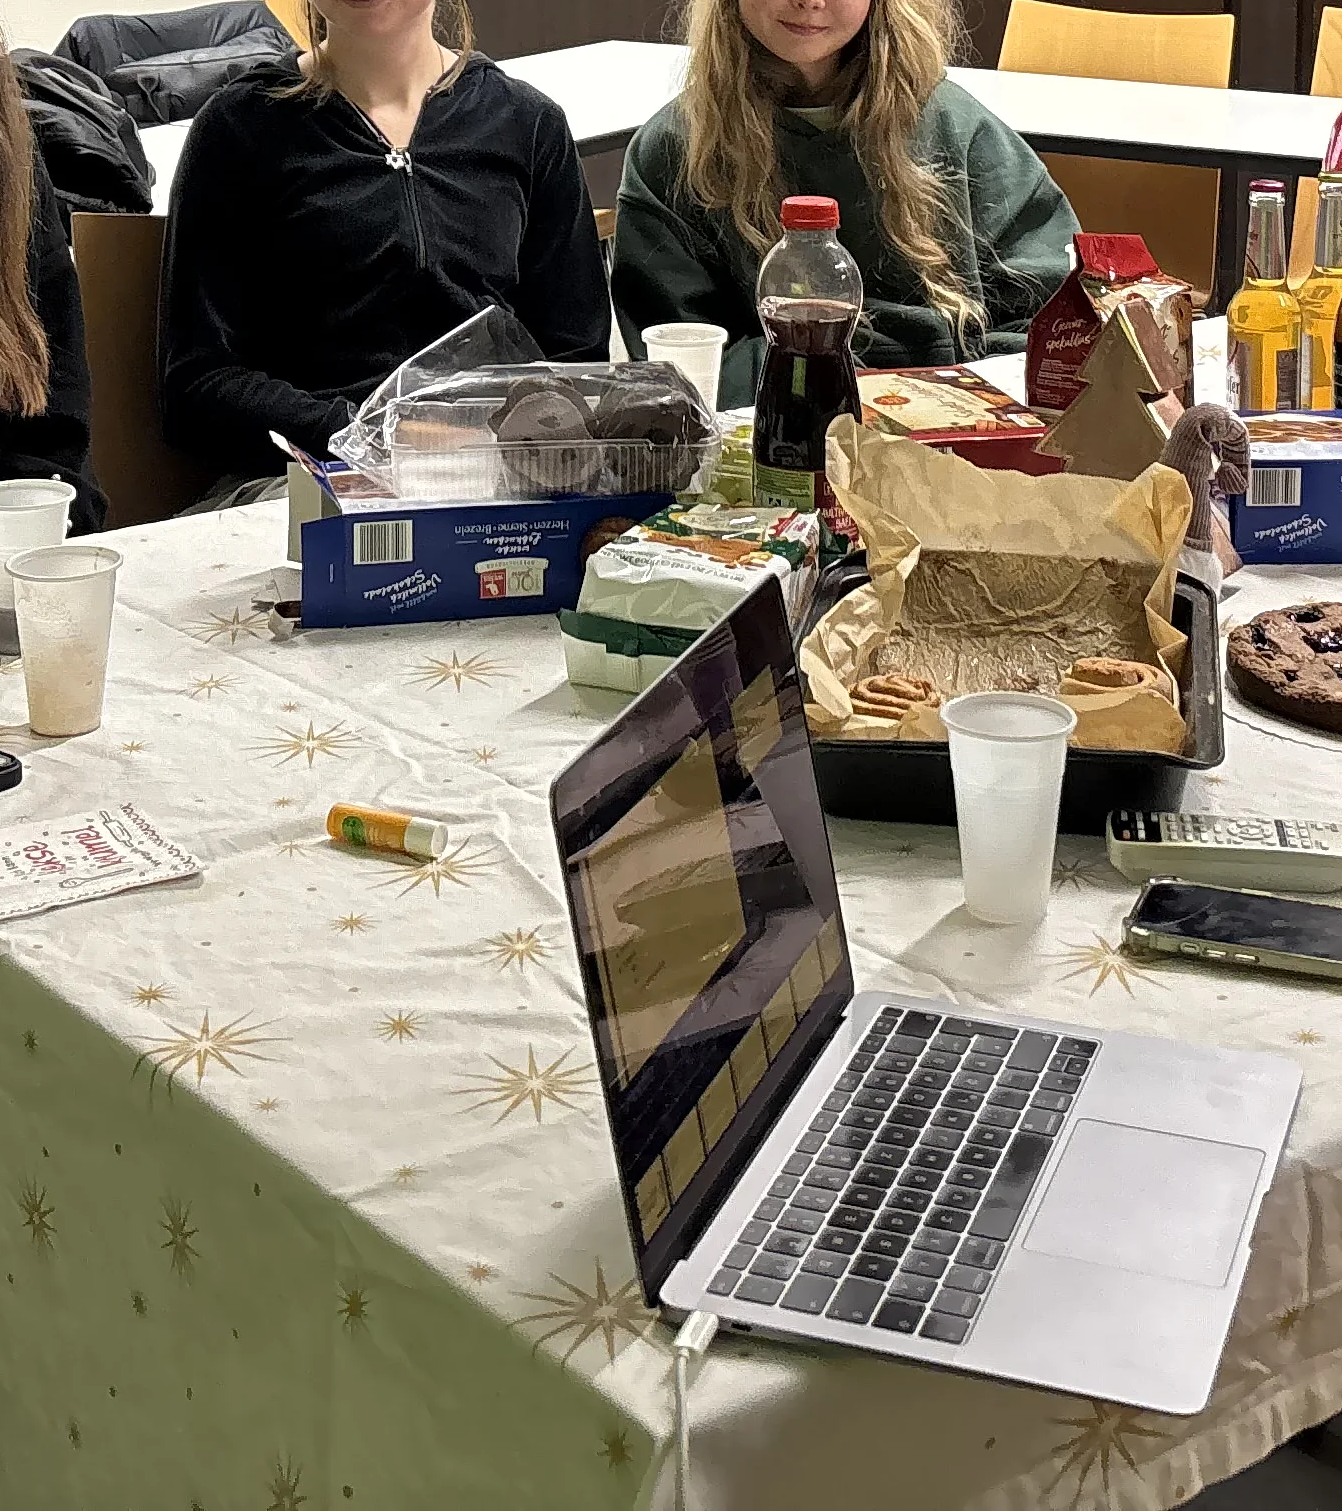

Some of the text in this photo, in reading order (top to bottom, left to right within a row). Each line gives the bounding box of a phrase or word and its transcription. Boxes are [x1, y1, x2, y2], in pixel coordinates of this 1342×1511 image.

[483, 531, 542, 546] Lebkuchen
[1253, 513, 1312, 539] Schokolade
[1279, 517, 1328, 544] Vollmilch
[363, 568, 426, 601] Schokolade
[390, 573, 442, 604] Vollmilch
